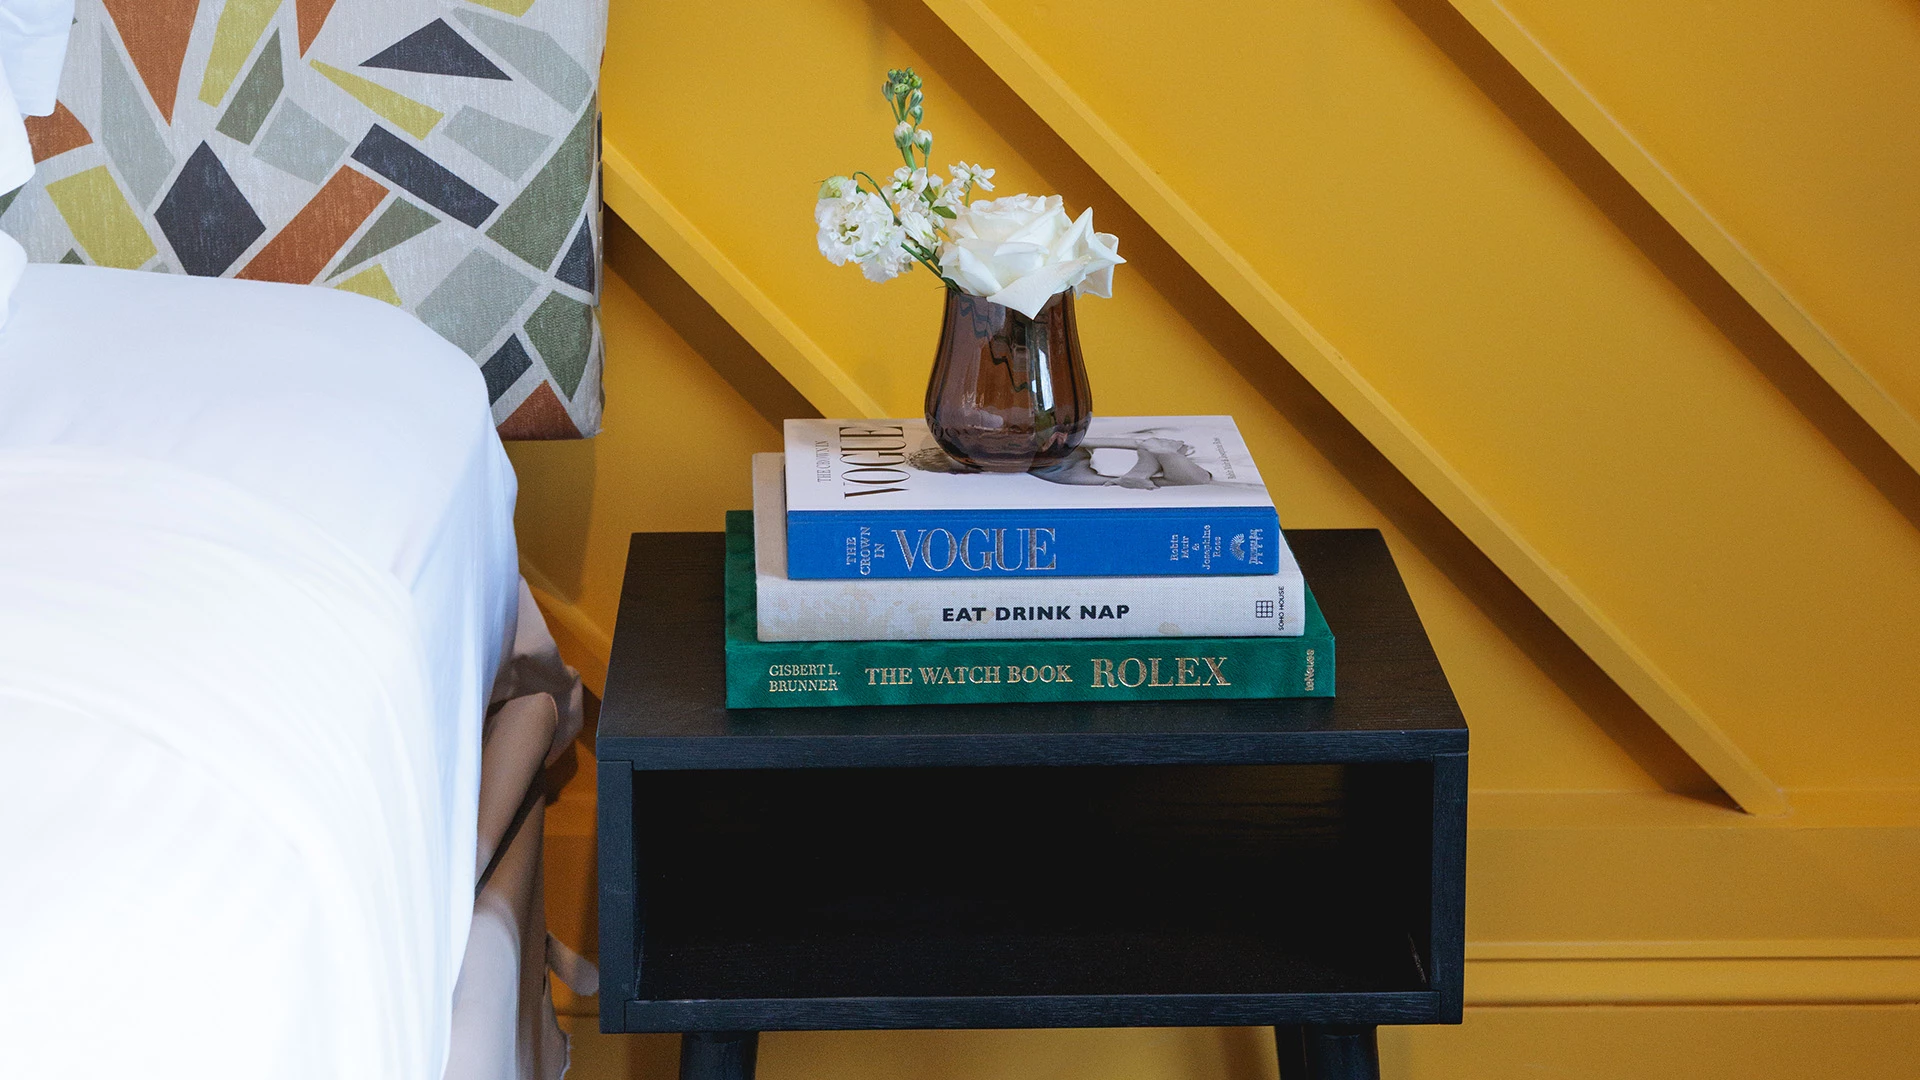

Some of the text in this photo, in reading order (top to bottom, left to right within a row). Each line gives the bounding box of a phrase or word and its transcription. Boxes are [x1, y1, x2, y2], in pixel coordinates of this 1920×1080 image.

[839, 426, 911, 499] VOGUE
[817, 470, 831, 482] THE
[846, 536, 857, 566] THE
[860, 526, 871, 576] CROWN
[874, 543, 885, 559] IN
[891, 527, 1057, 572] VOGUE
[1170, 534, 1179, 561] Robin
[1181, 535, 1190, 559] Muir
[1191, 543, 1200, 551] &
[1202, 524, 1212, 570] Josephine
[1213, 536, 1222, 558] Ross
[942, 604, 1130, 622] EAT DRINK NAP
[769, 663, 841, 676] GISBERT L.
[864, 665, 1073, 685] THE WATCH BOOK
[1090, 657, 1232, 688] ROLEX
[769, 679, 839, 692] BRUNNER
